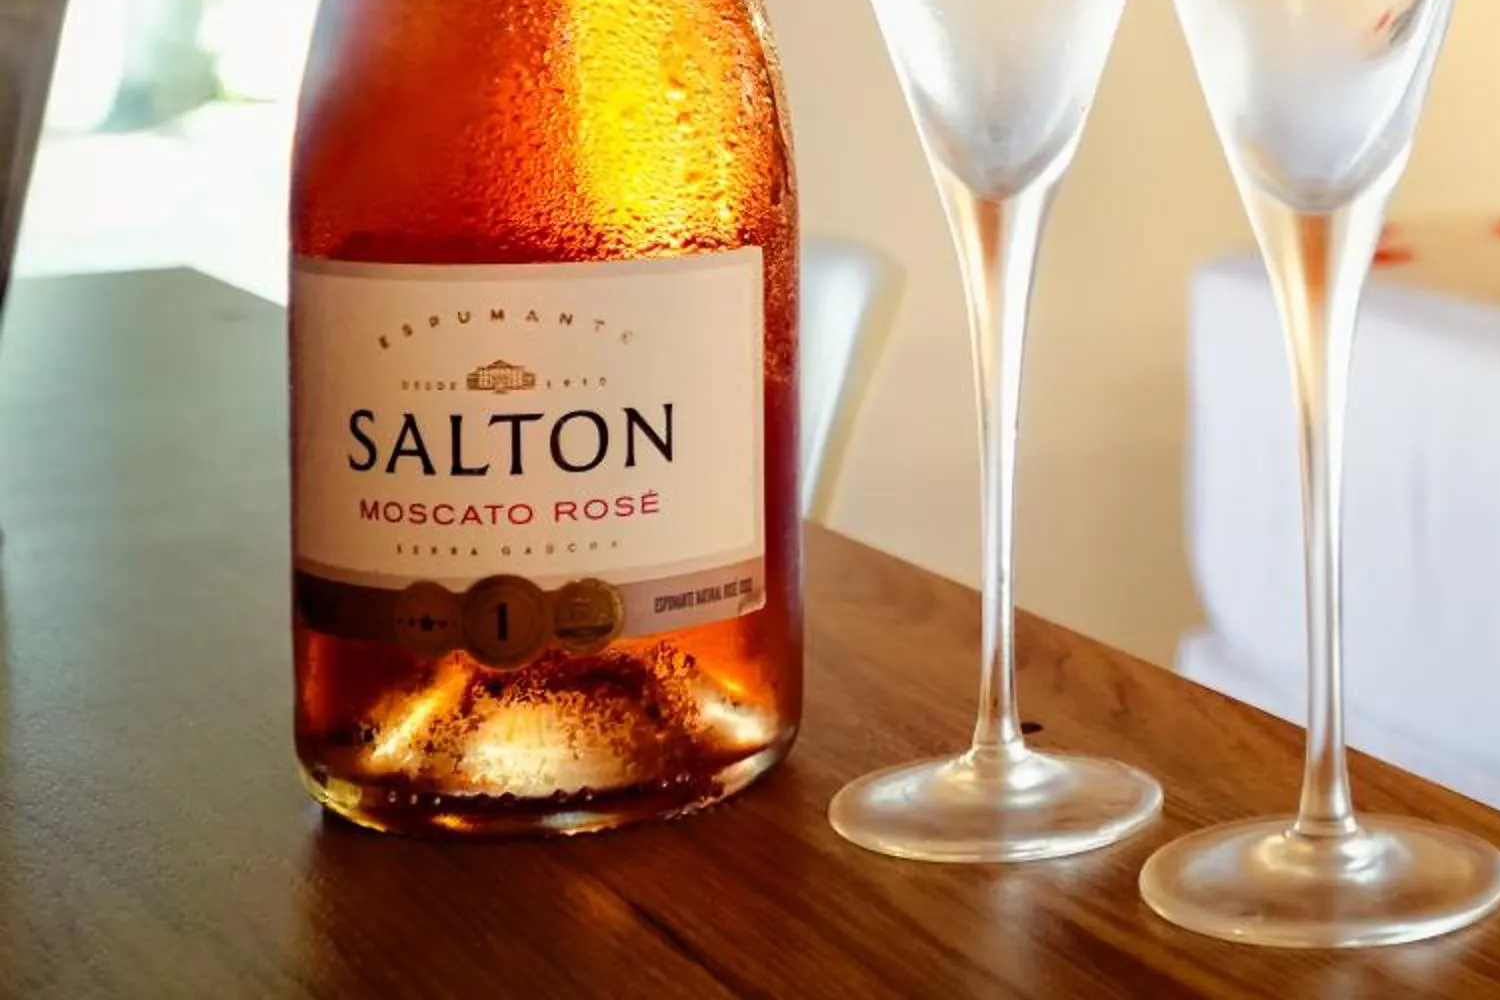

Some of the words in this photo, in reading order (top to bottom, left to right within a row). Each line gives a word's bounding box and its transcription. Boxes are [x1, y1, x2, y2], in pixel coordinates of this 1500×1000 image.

[347, 402, 675, 477] SALTON
[360, 498, 533, 526] MOSCATO
[554, 489, 660, 524] ROSÉ
